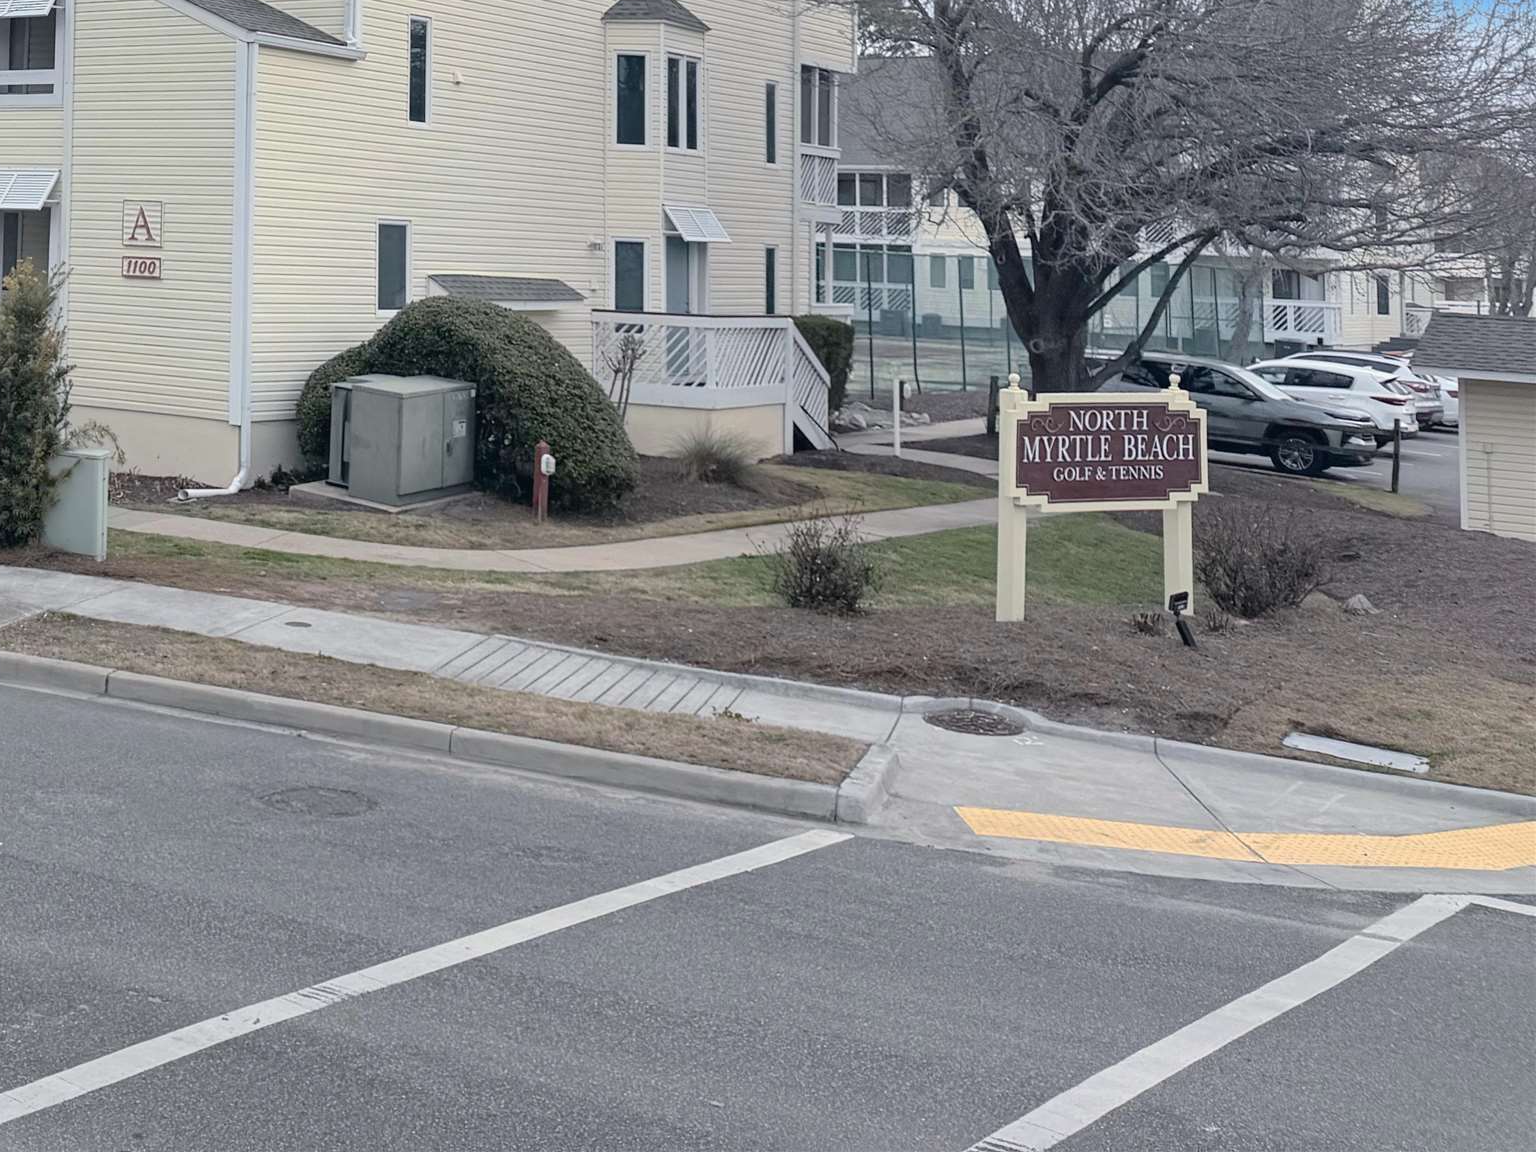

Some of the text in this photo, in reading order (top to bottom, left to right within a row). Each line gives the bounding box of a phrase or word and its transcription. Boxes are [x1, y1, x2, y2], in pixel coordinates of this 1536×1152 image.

[128, 205, 156, 241] A
[125, 259, 157, 275] 1100
[1069, 409, 1149, 432] NORTH
[1022, 433, 1195, 463] MYRTLE BEACH
[1053, 464, 1164, 482] GOLF & TENNIS
